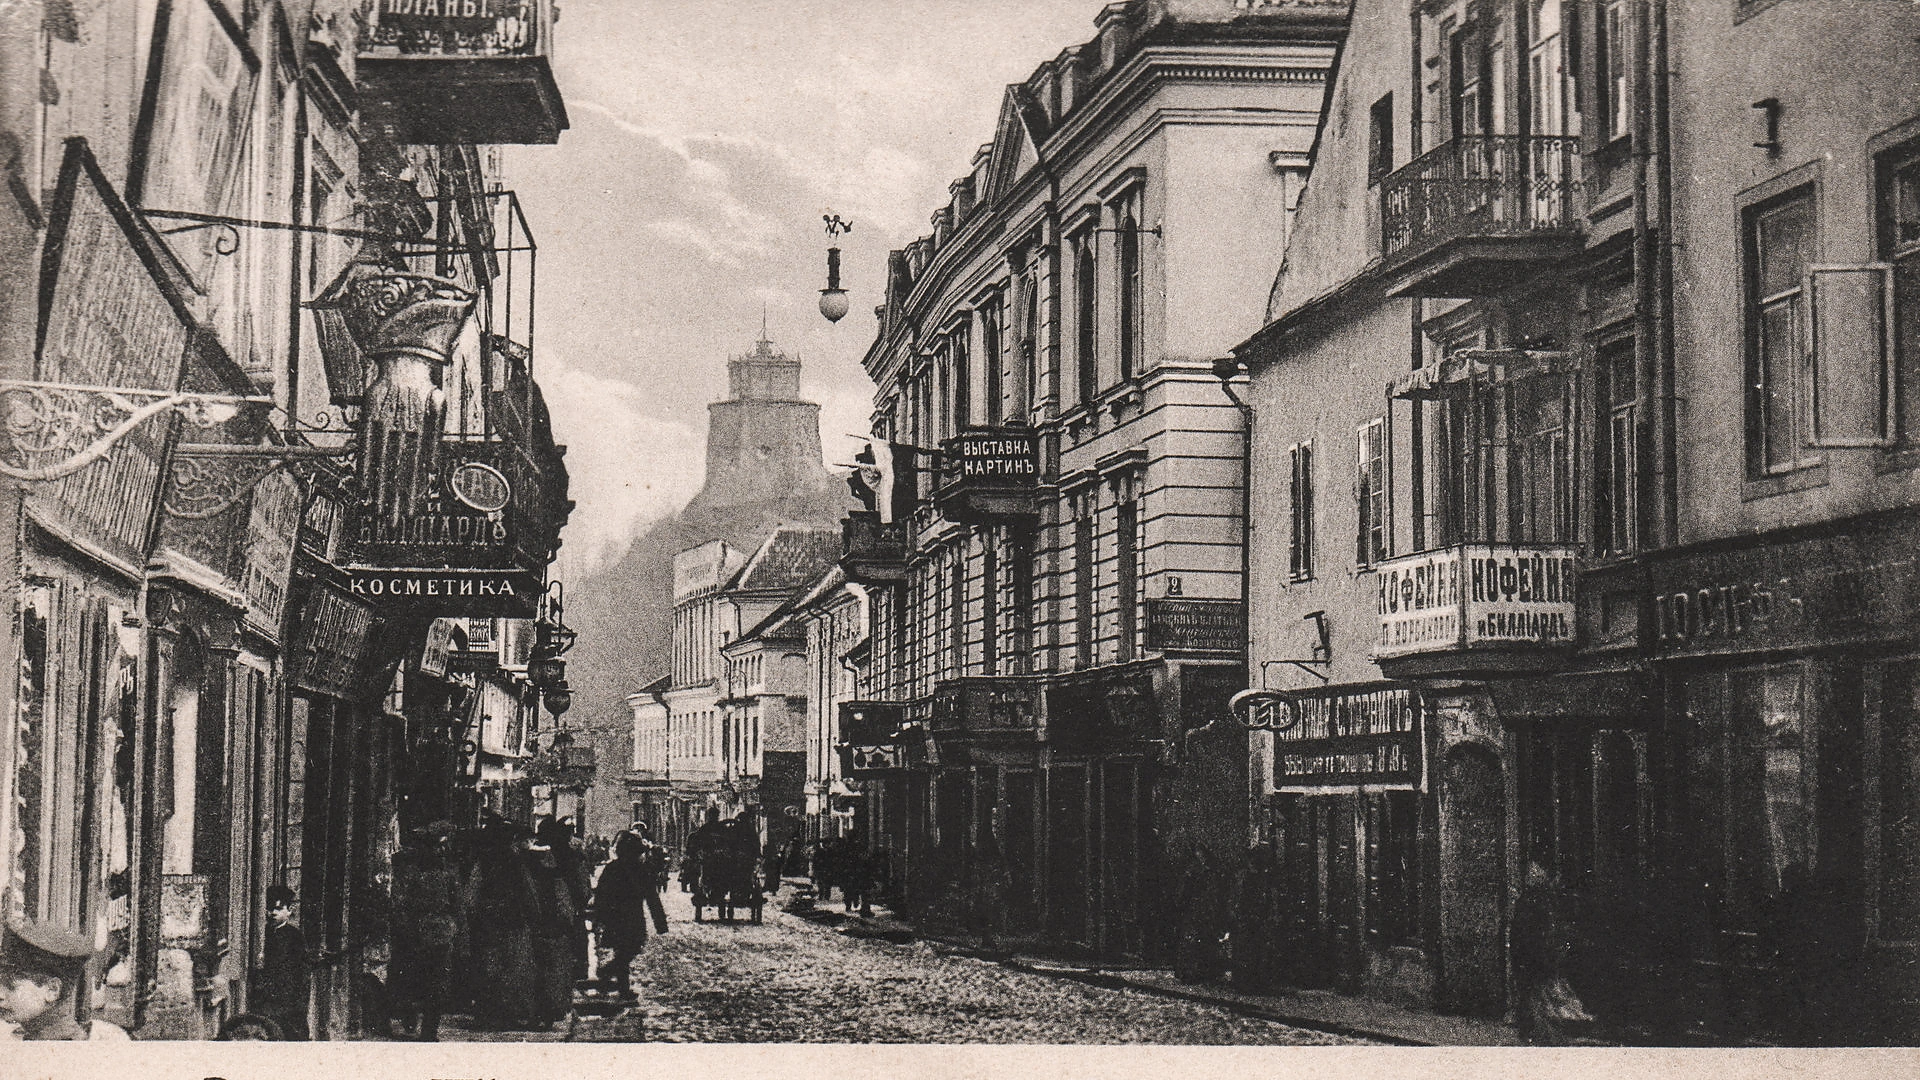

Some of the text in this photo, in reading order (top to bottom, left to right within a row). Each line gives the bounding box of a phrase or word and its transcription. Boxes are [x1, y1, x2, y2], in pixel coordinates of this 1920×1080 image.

[963, 439, 1031, 456] ВЫСТАВКА
[964, 459, 1034, 475] КАРТИНЪ
[350, 579, 515, 595] КОСМЕТИКА
